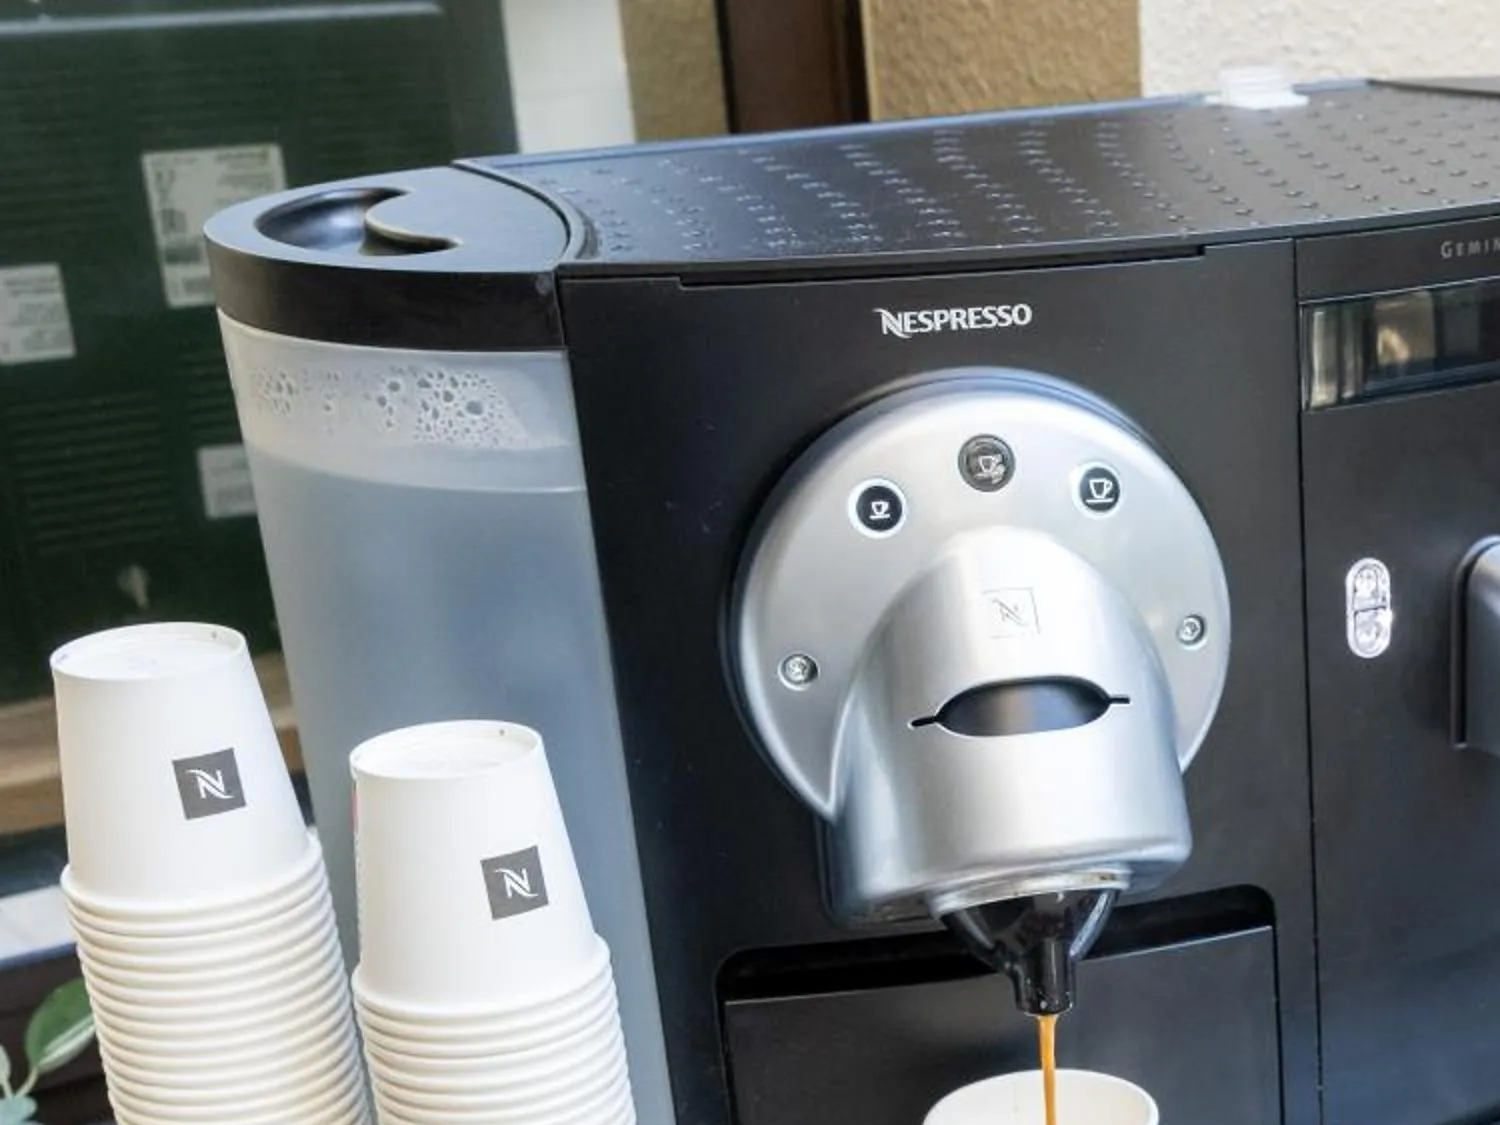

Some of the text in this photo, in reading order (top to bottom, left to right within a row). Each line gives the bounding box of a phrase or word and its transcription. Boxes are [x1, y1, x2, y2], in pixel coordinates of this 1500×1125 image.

[872, 303, 1034, 339] NESPRESSO
[185, 768, 235, 799] N
[493, 867, 539, 899] N
